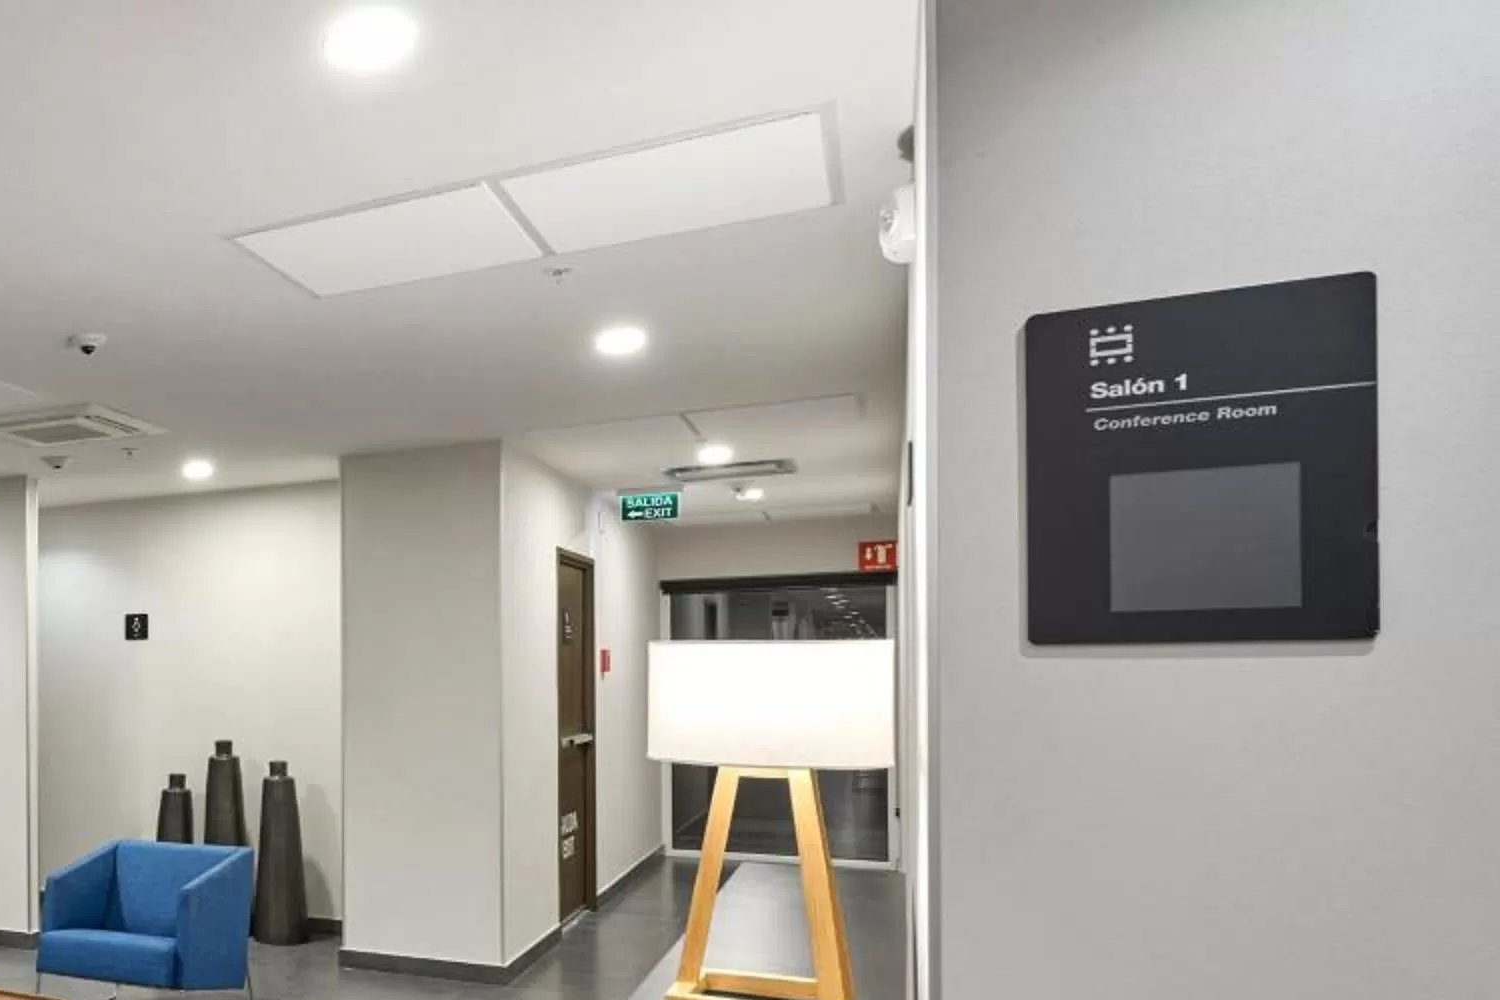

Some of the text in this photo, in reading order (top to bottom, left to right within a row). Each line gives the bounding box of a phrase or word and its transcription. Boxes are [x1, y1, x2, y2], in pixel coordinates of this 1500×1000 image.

[1090, 373, 1188, 399] Salón 1
[1093, 405, 1277, 431] Conference Room
[626, 495, 673, 508] SALIDA
[645, 507, 672, 518] EXIT
